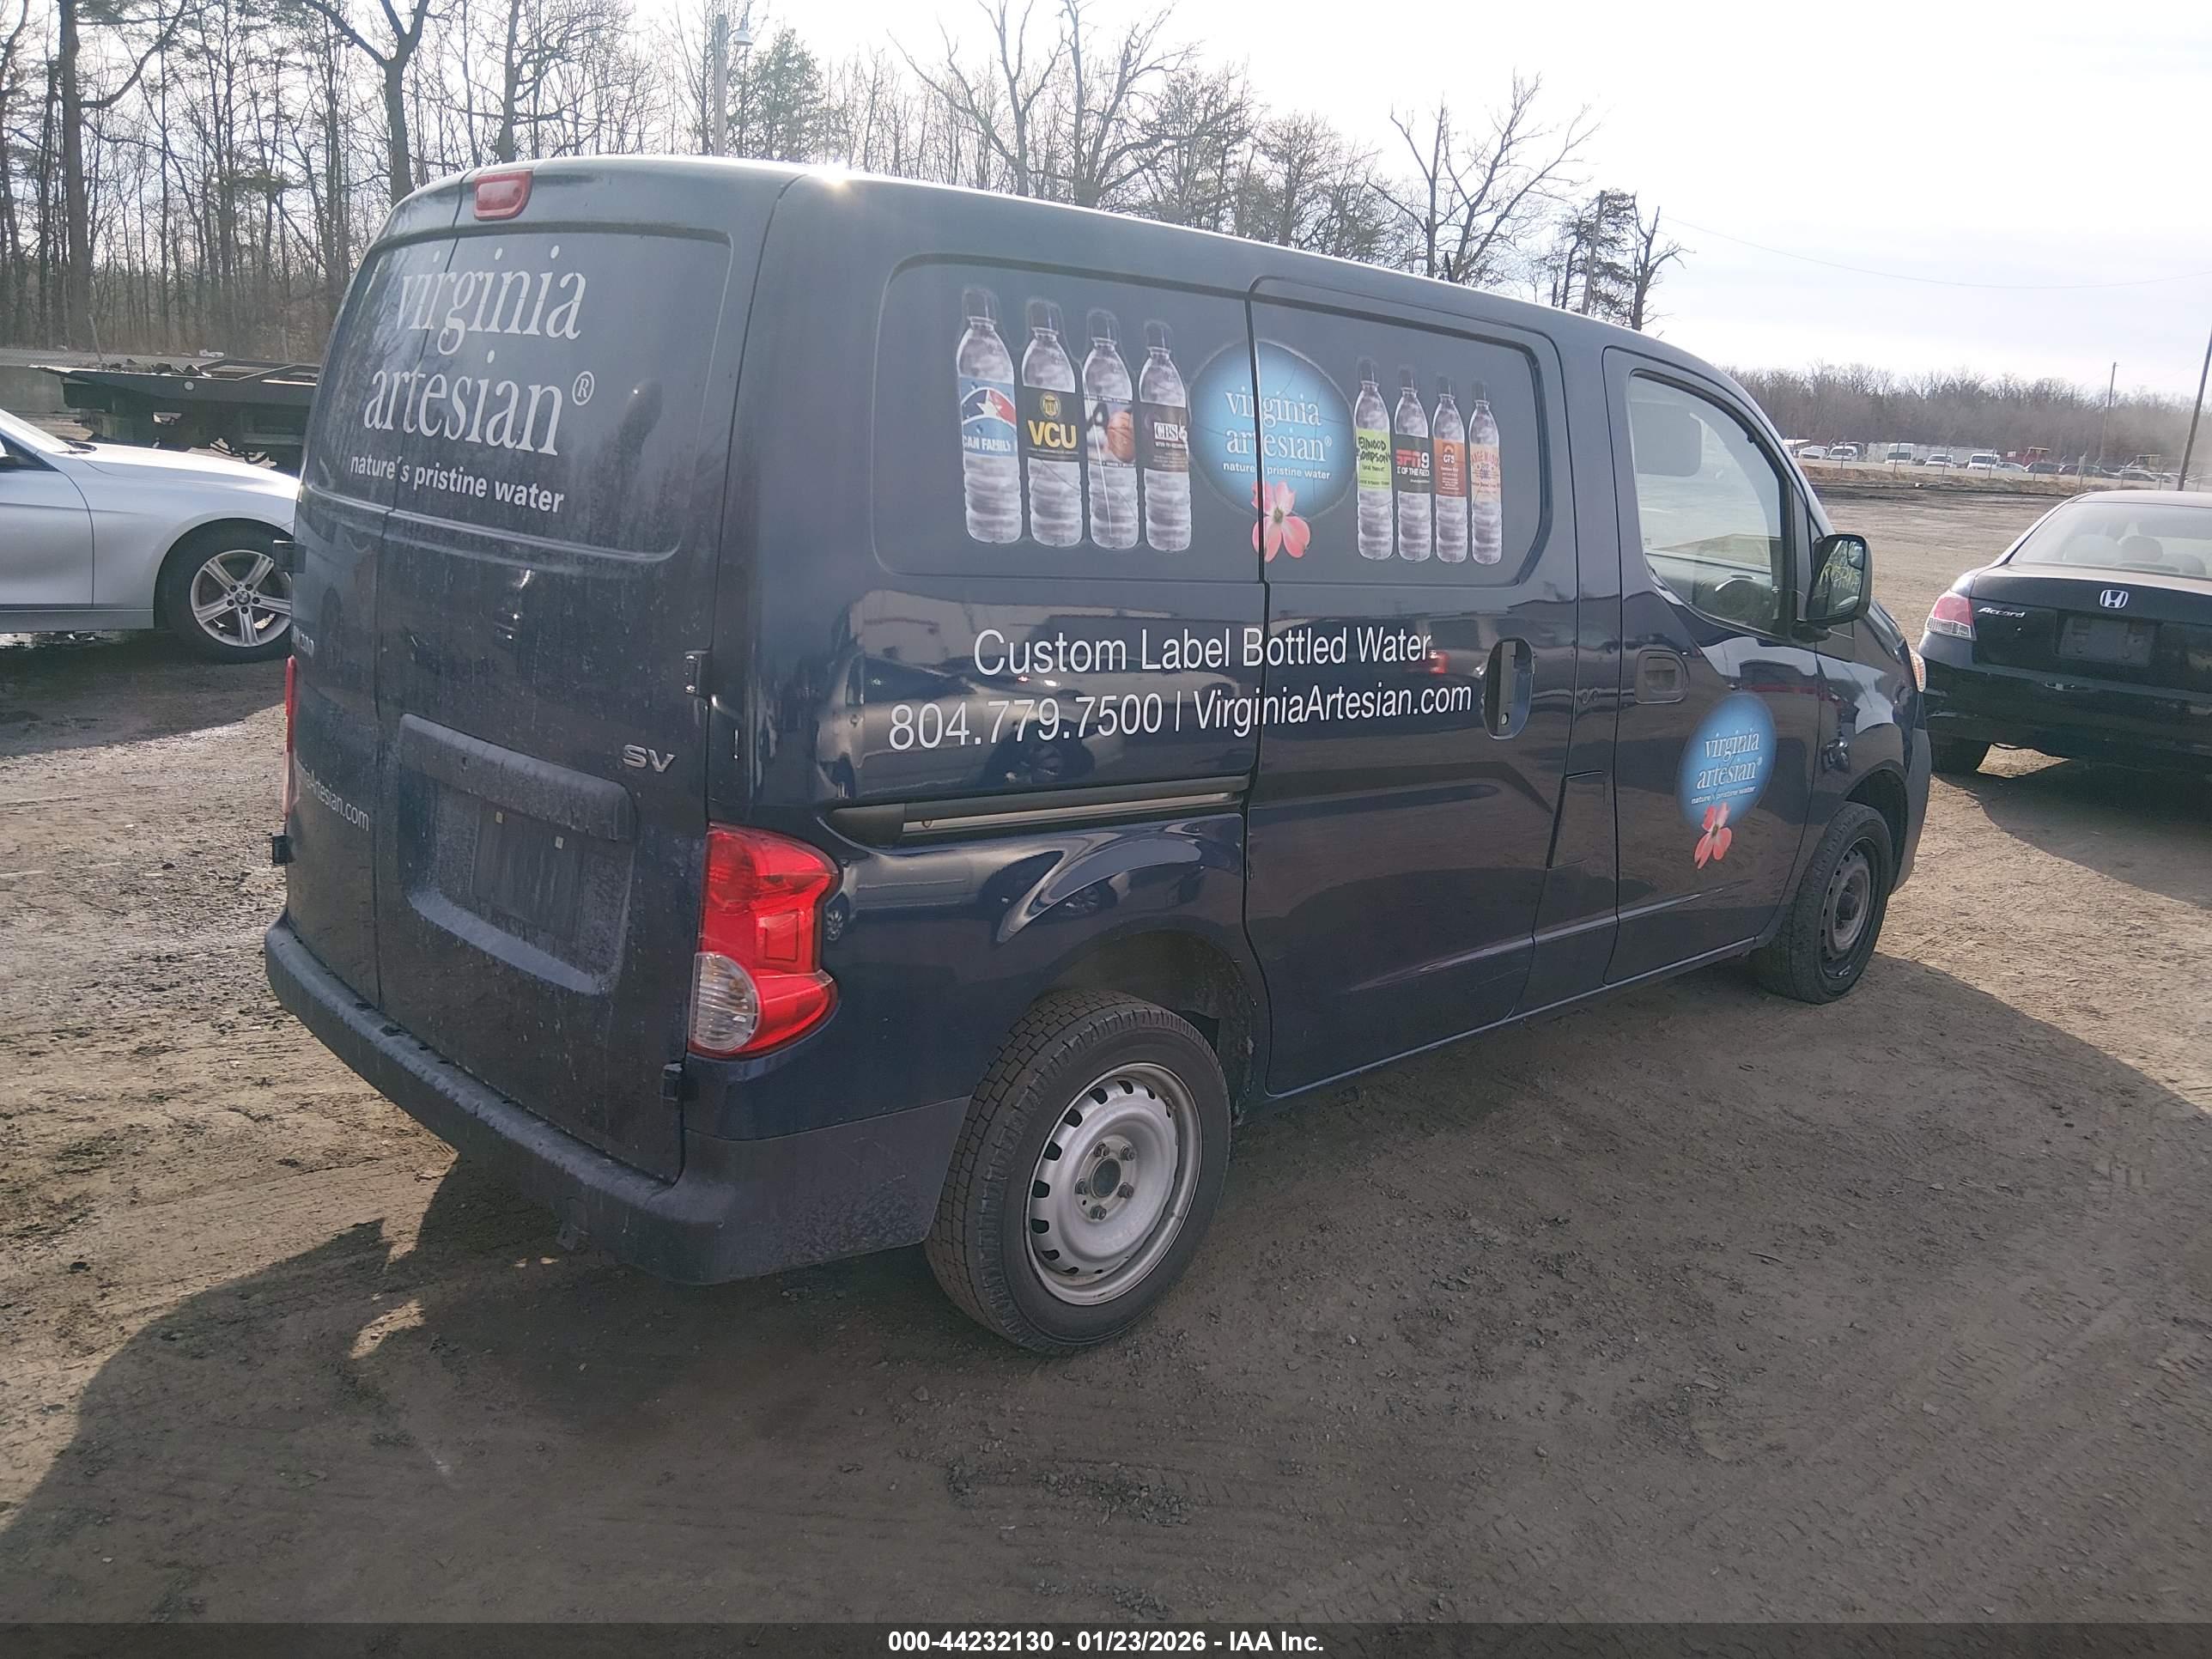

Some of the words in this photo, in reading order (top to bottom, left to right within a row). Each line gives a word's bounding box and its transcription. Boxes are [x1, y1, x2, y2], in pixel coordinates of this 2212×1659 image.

[397, 246, 587, 356] virginia
[1225, 386, 1322, 428] virginia
[1028, 419, 1077, 449] VCU
[413, 462, 488, 498] pristine
[495, 480, 565, 514] water
[1267, 466, 1302, 478] pristine
[1304, 470, 1330, 480] water
[1978, 607, 2026, 618] Accord
[974, 628, 1127, 677] Custom
[1141, 627, 1231, 671] Label
[1243, 626, 1348, 668] Bottled
[1356, 625, 1433, 664] Water
[888, 693, 1163, 751] 804.779.7500
[1194, 682, 1473, 738] VirginiaArtesian.com
[623, 744, 676, 772] SV
[1705, 728, 1759, 763] virginia
